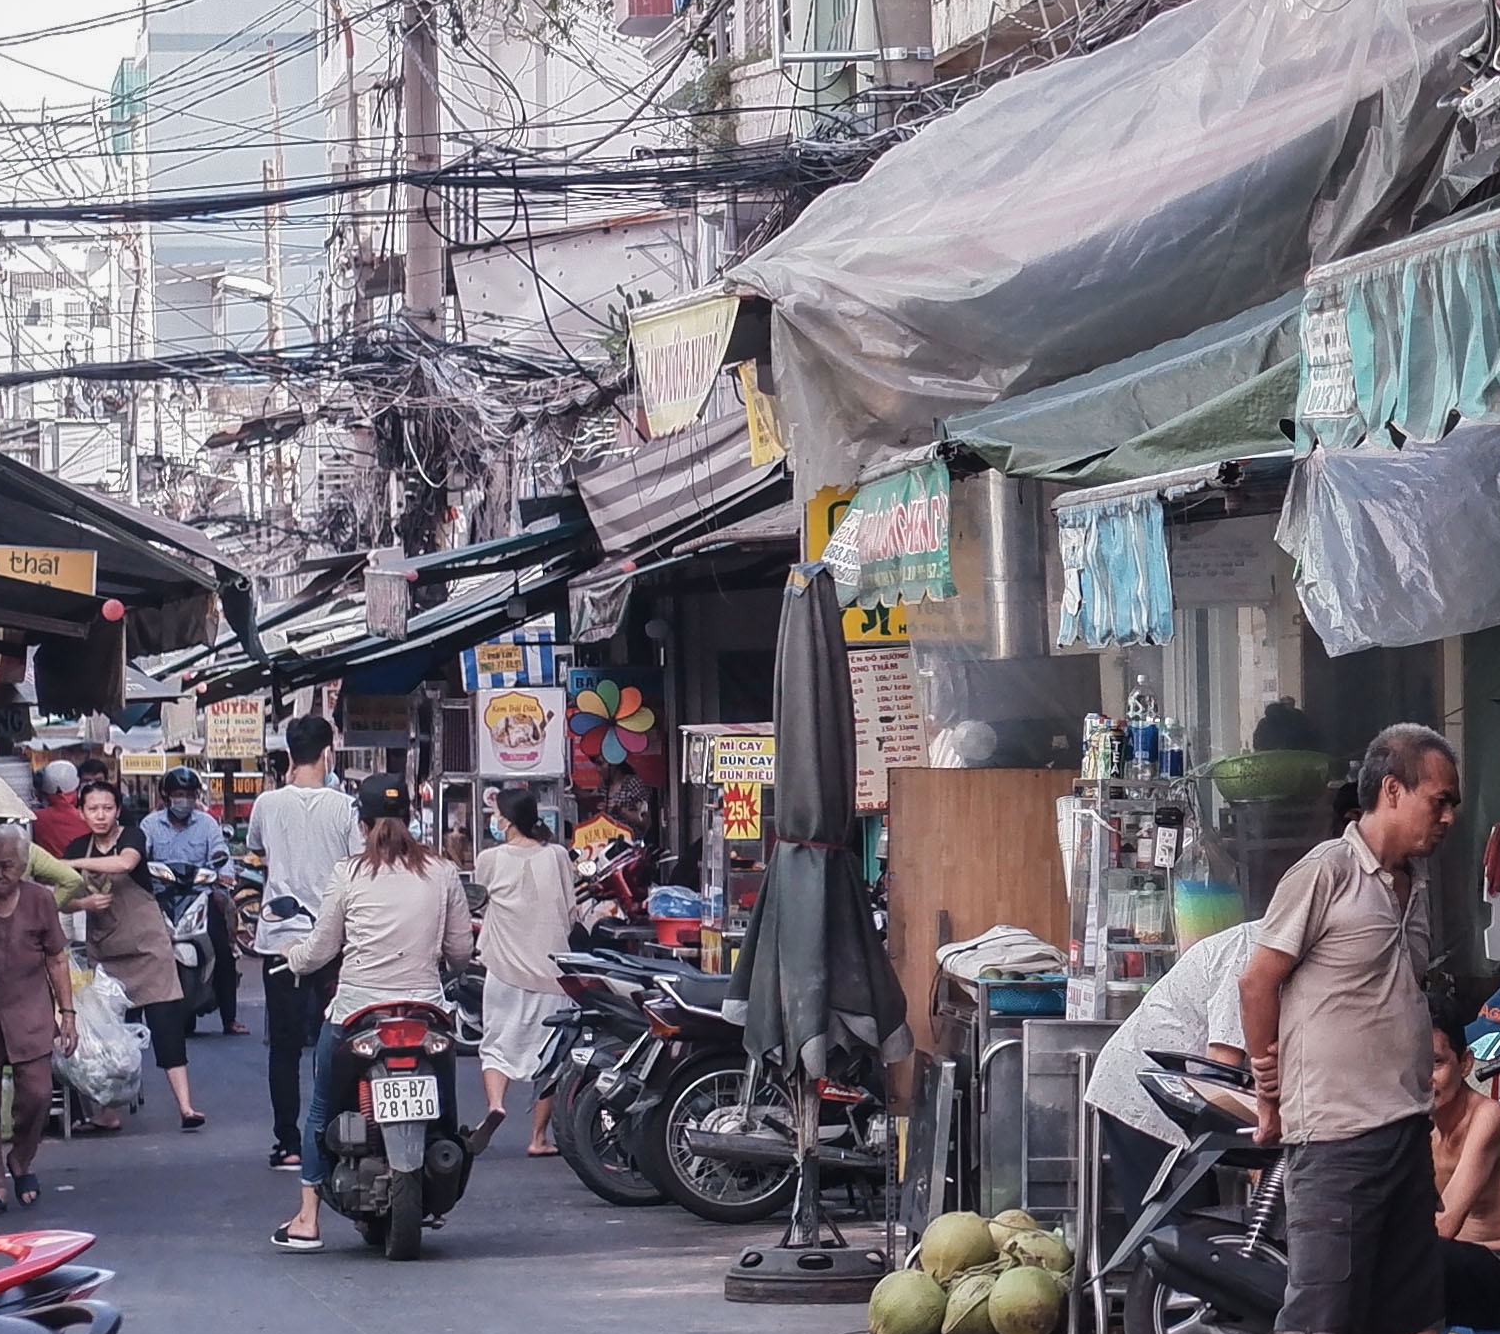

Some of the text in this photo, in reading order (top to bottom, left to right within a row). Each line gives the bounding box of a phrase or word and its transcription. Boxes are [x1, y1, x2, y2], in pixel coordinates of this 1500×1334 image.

[9, 551, 61, 576] thái
[719, 739, 763, 752] MÌ CAY
[749, 756, 774, 767] CAY
[1110, 740, 1121, 775] TEA
[746, 768, 774, 781] RIÊU
[728, 800, 751, 821] 25k
[383, 1080, 426, 1099] 86-B7
[378, 1098, 435, 1119] 281.30
